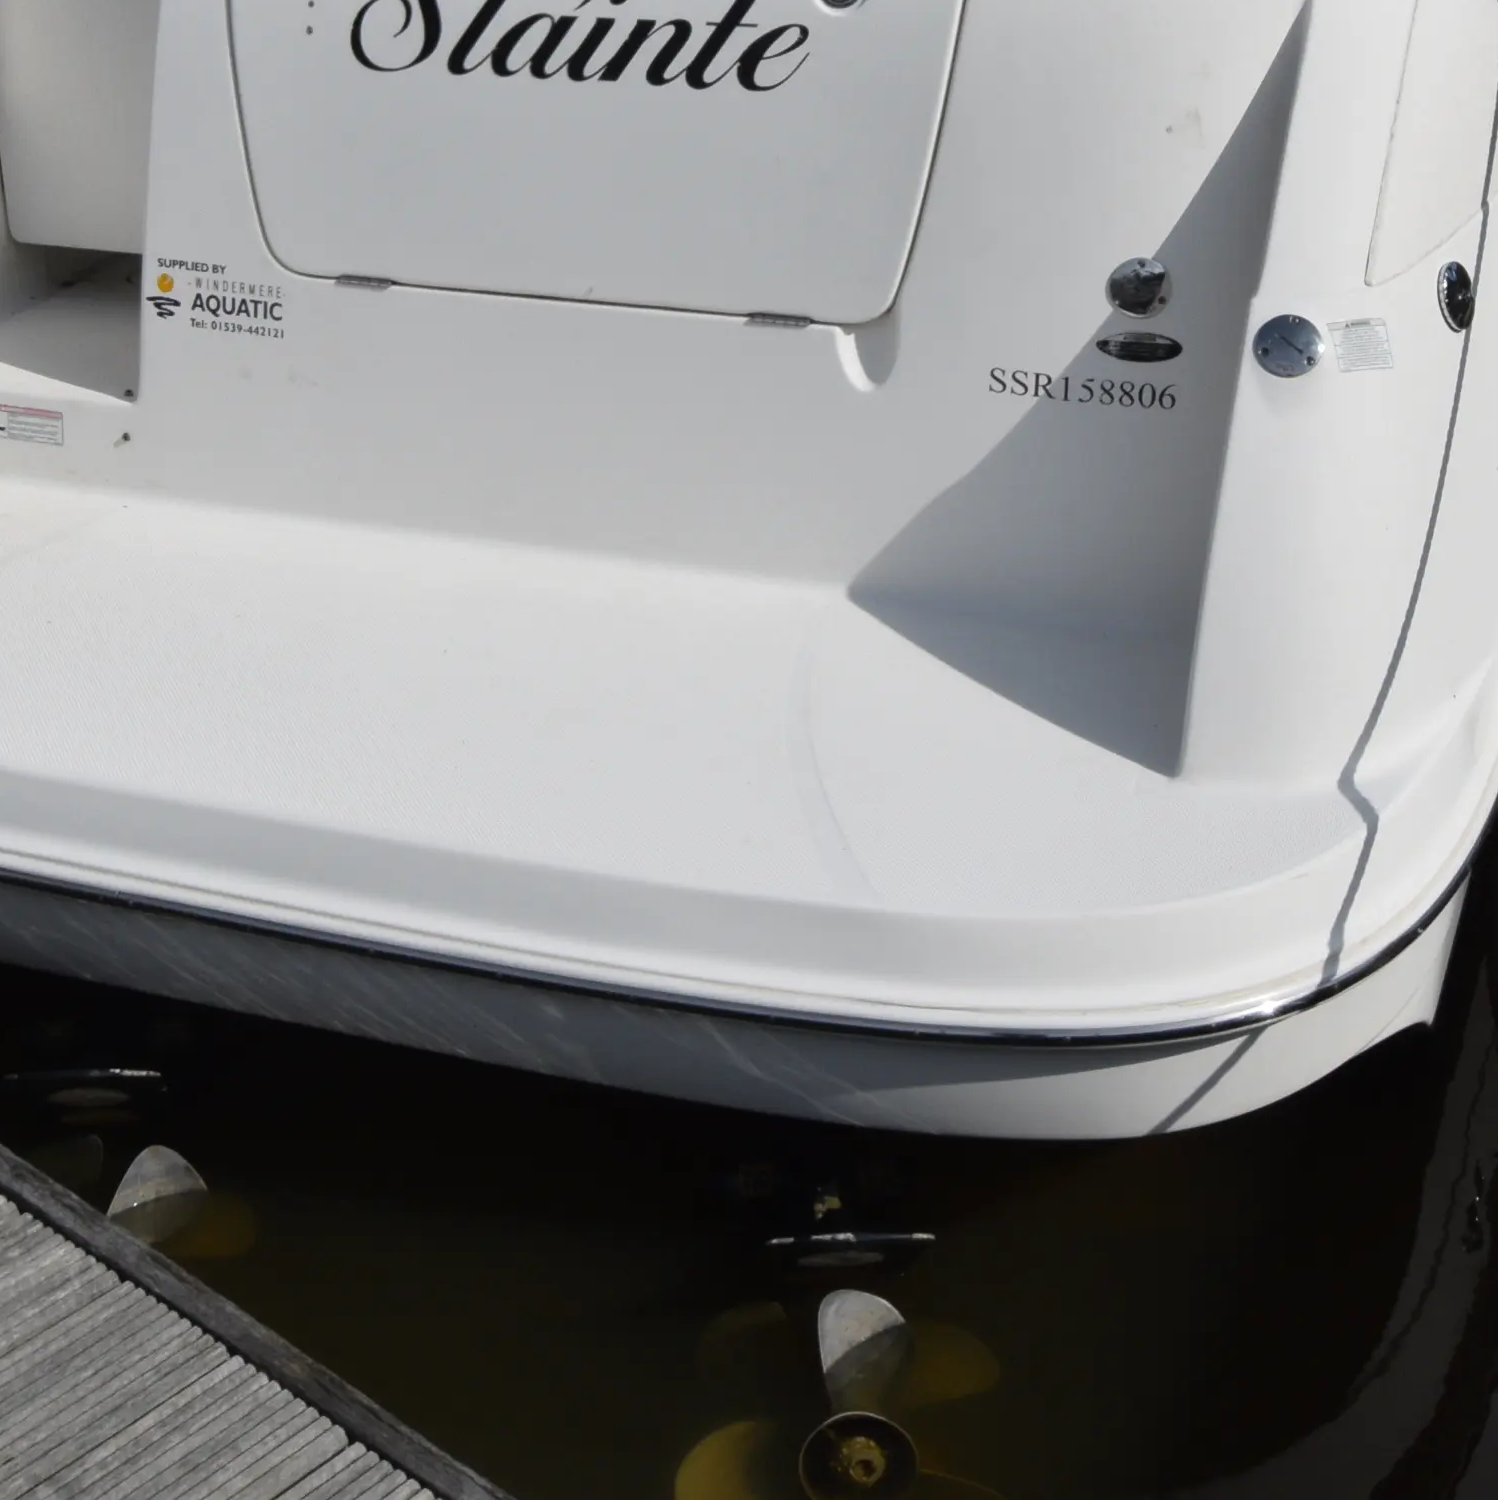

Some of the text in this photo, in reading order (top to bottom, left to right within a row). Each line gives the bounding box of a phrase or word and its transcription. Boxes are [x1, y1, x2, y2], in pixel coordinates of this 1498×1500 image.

[157, 258, 226, 275] SUPPLIED BY
[191, 293, 283, 321] AQUATIC
[190, 318, 284, 339] Tel: 01539-442121
[988, 367, 1177, 410] SSR158806
